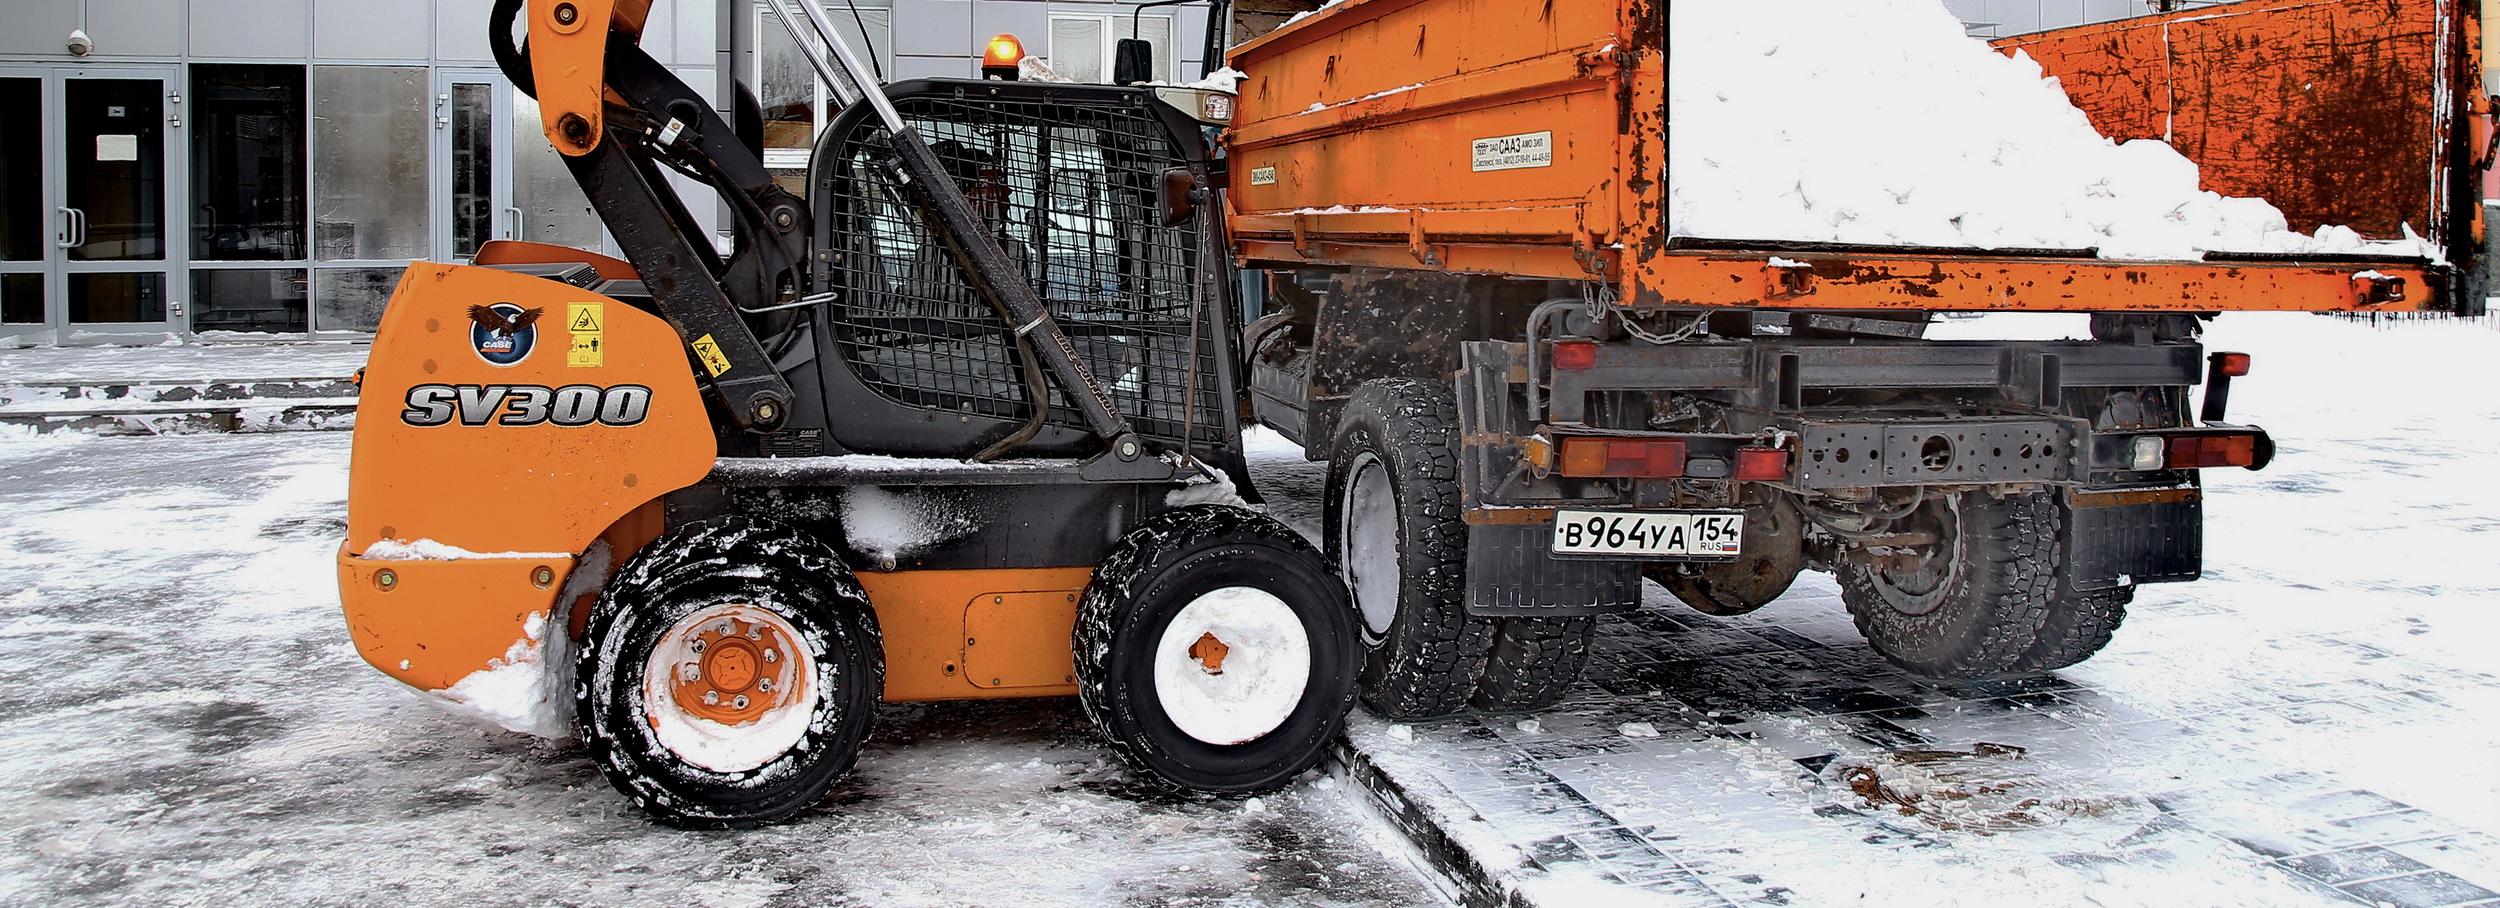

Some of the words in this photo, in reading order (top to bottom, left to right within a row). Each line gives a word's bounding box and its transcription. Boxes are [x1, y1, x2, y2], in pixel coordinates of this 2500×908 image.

[1499, 137, 1520, 154] СААЗ
[482, 340, 513, 349] CASE
[1074, 361, 1116, 419] CONTROL
[401, 384, 652, 426] SV300
[1694, 517, 1736, 541] 154
[1700, 542, 1722, 551] RUS
